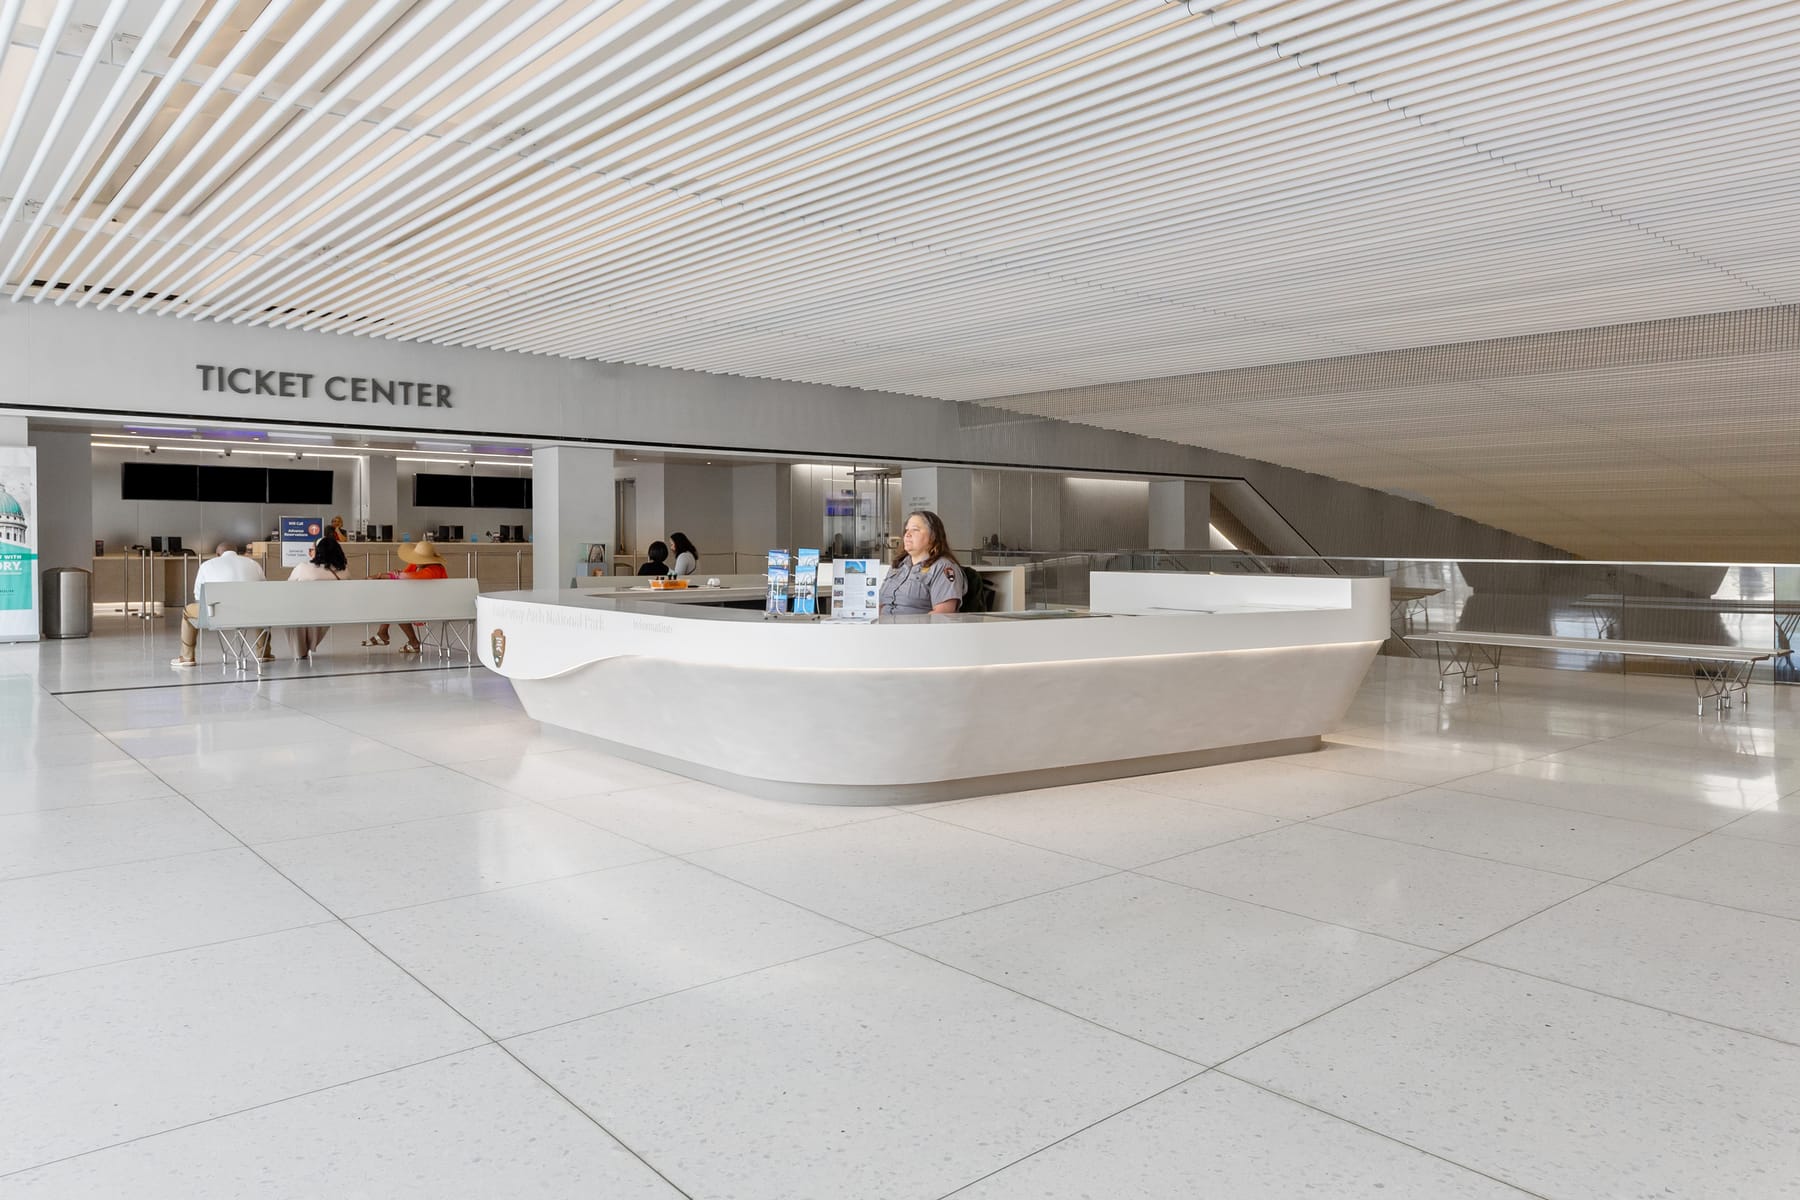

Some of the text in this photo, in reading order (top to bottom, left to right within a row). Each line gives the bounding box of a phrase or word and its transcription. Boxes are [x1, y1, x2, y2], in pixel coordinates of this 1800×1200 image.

[196, 364, 453, 408] TICKET CENTER
[547, 608, 582, 629] National
[584, 613, 605, 632] Park
[632, 617, 673, 634] Information
